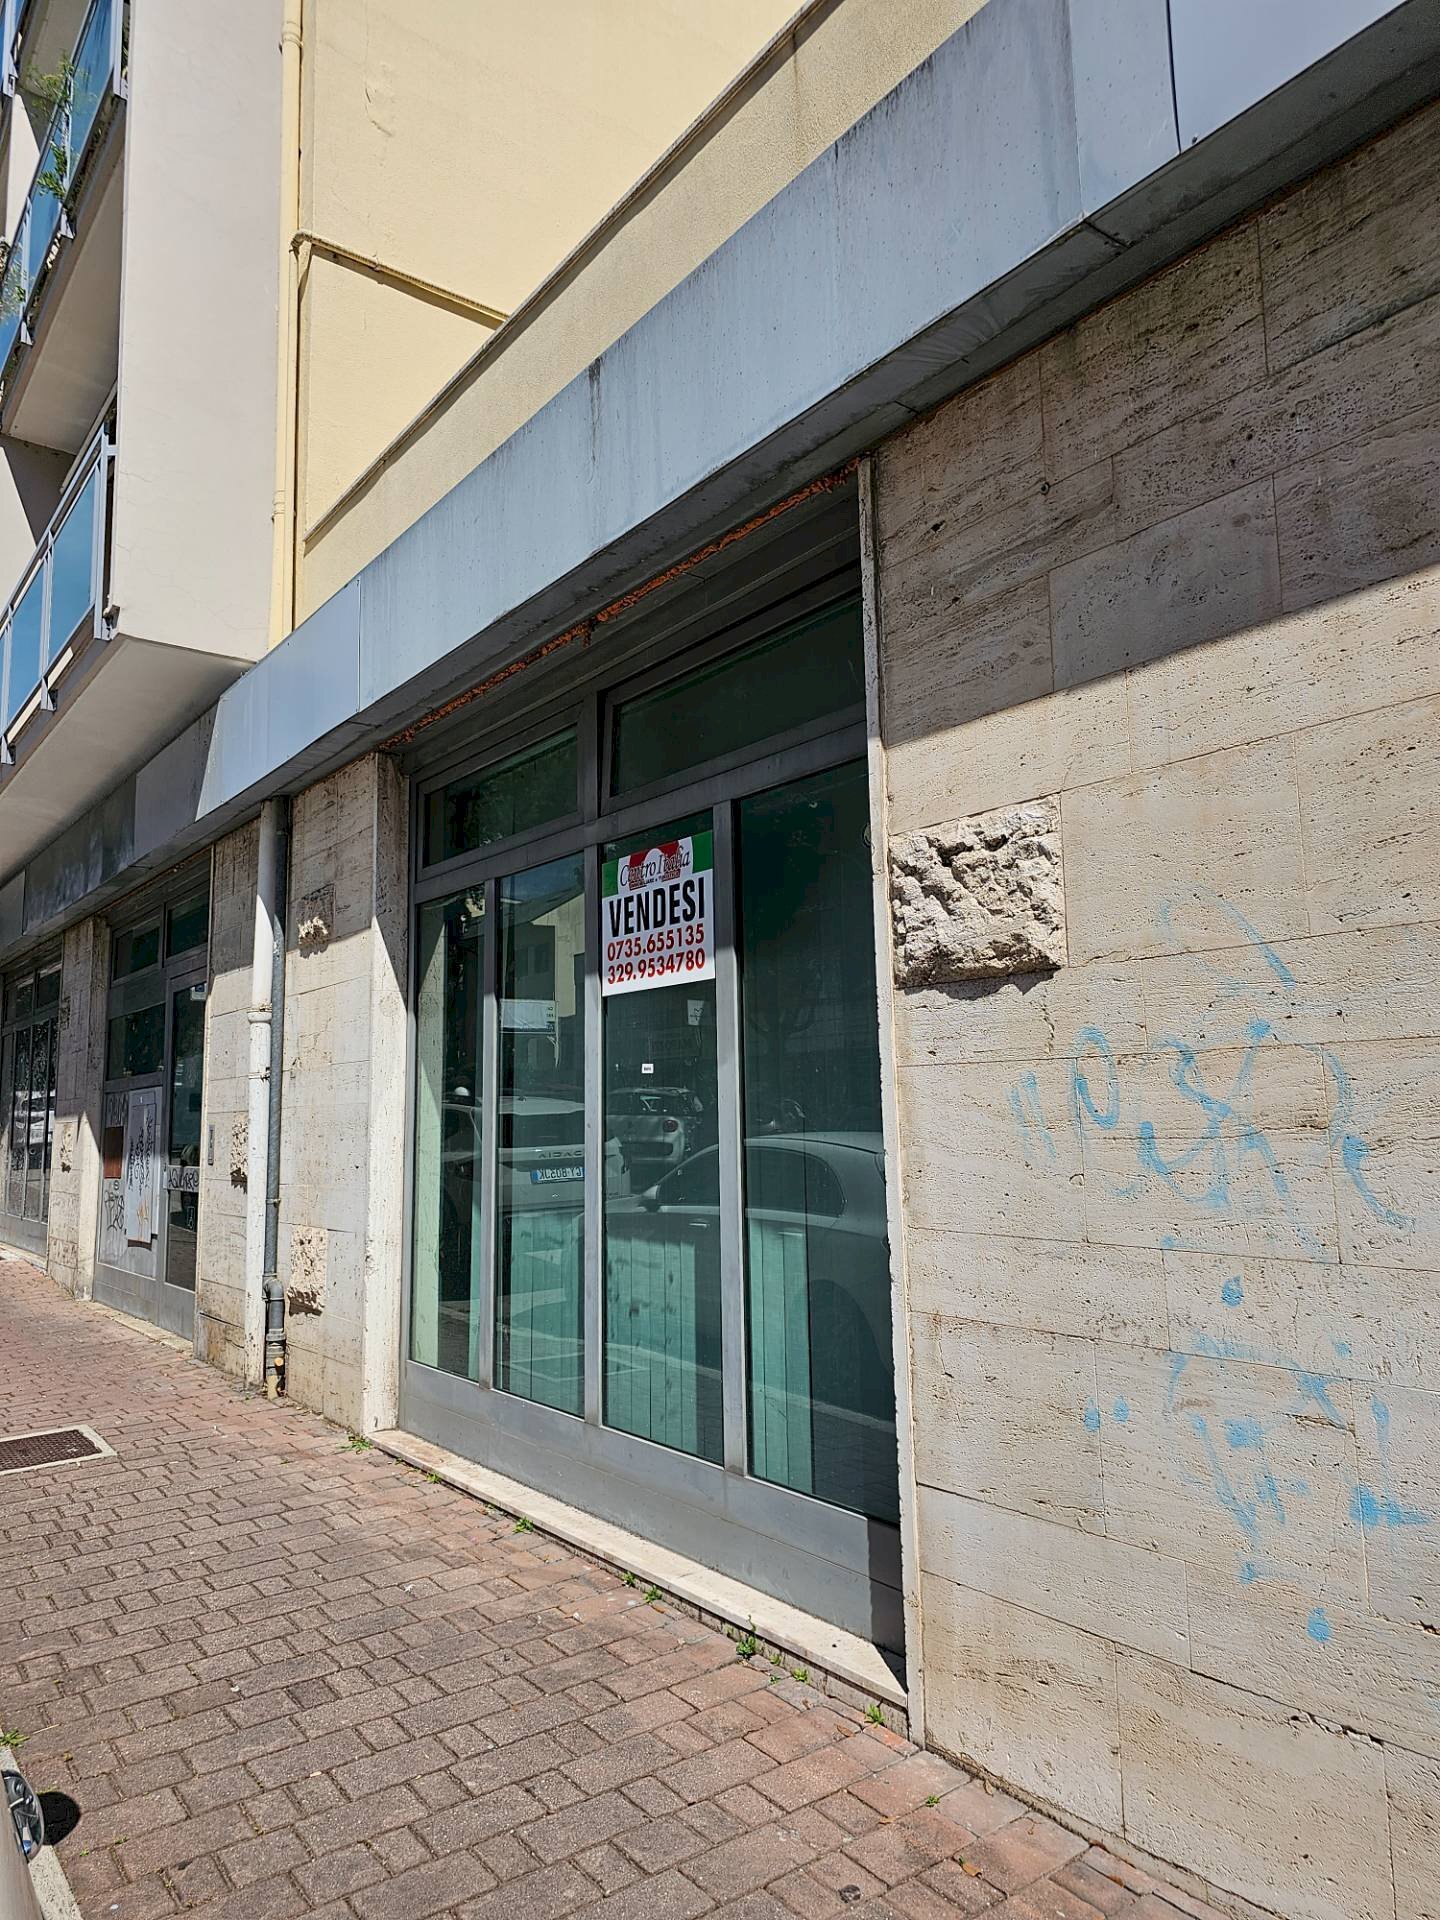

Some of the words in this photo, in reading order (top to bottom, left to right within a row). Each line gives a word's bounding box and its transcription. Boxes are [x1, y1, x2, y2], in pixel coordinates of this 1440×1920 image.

[620, 861, 656, 886] Centro
[656, 845, 690, 874] Italia
[609, 877, 705, 937] VENDESI
[607, 923, 704, 961] 0735.655135
[607, 948, 705, 984] 329.9534780
